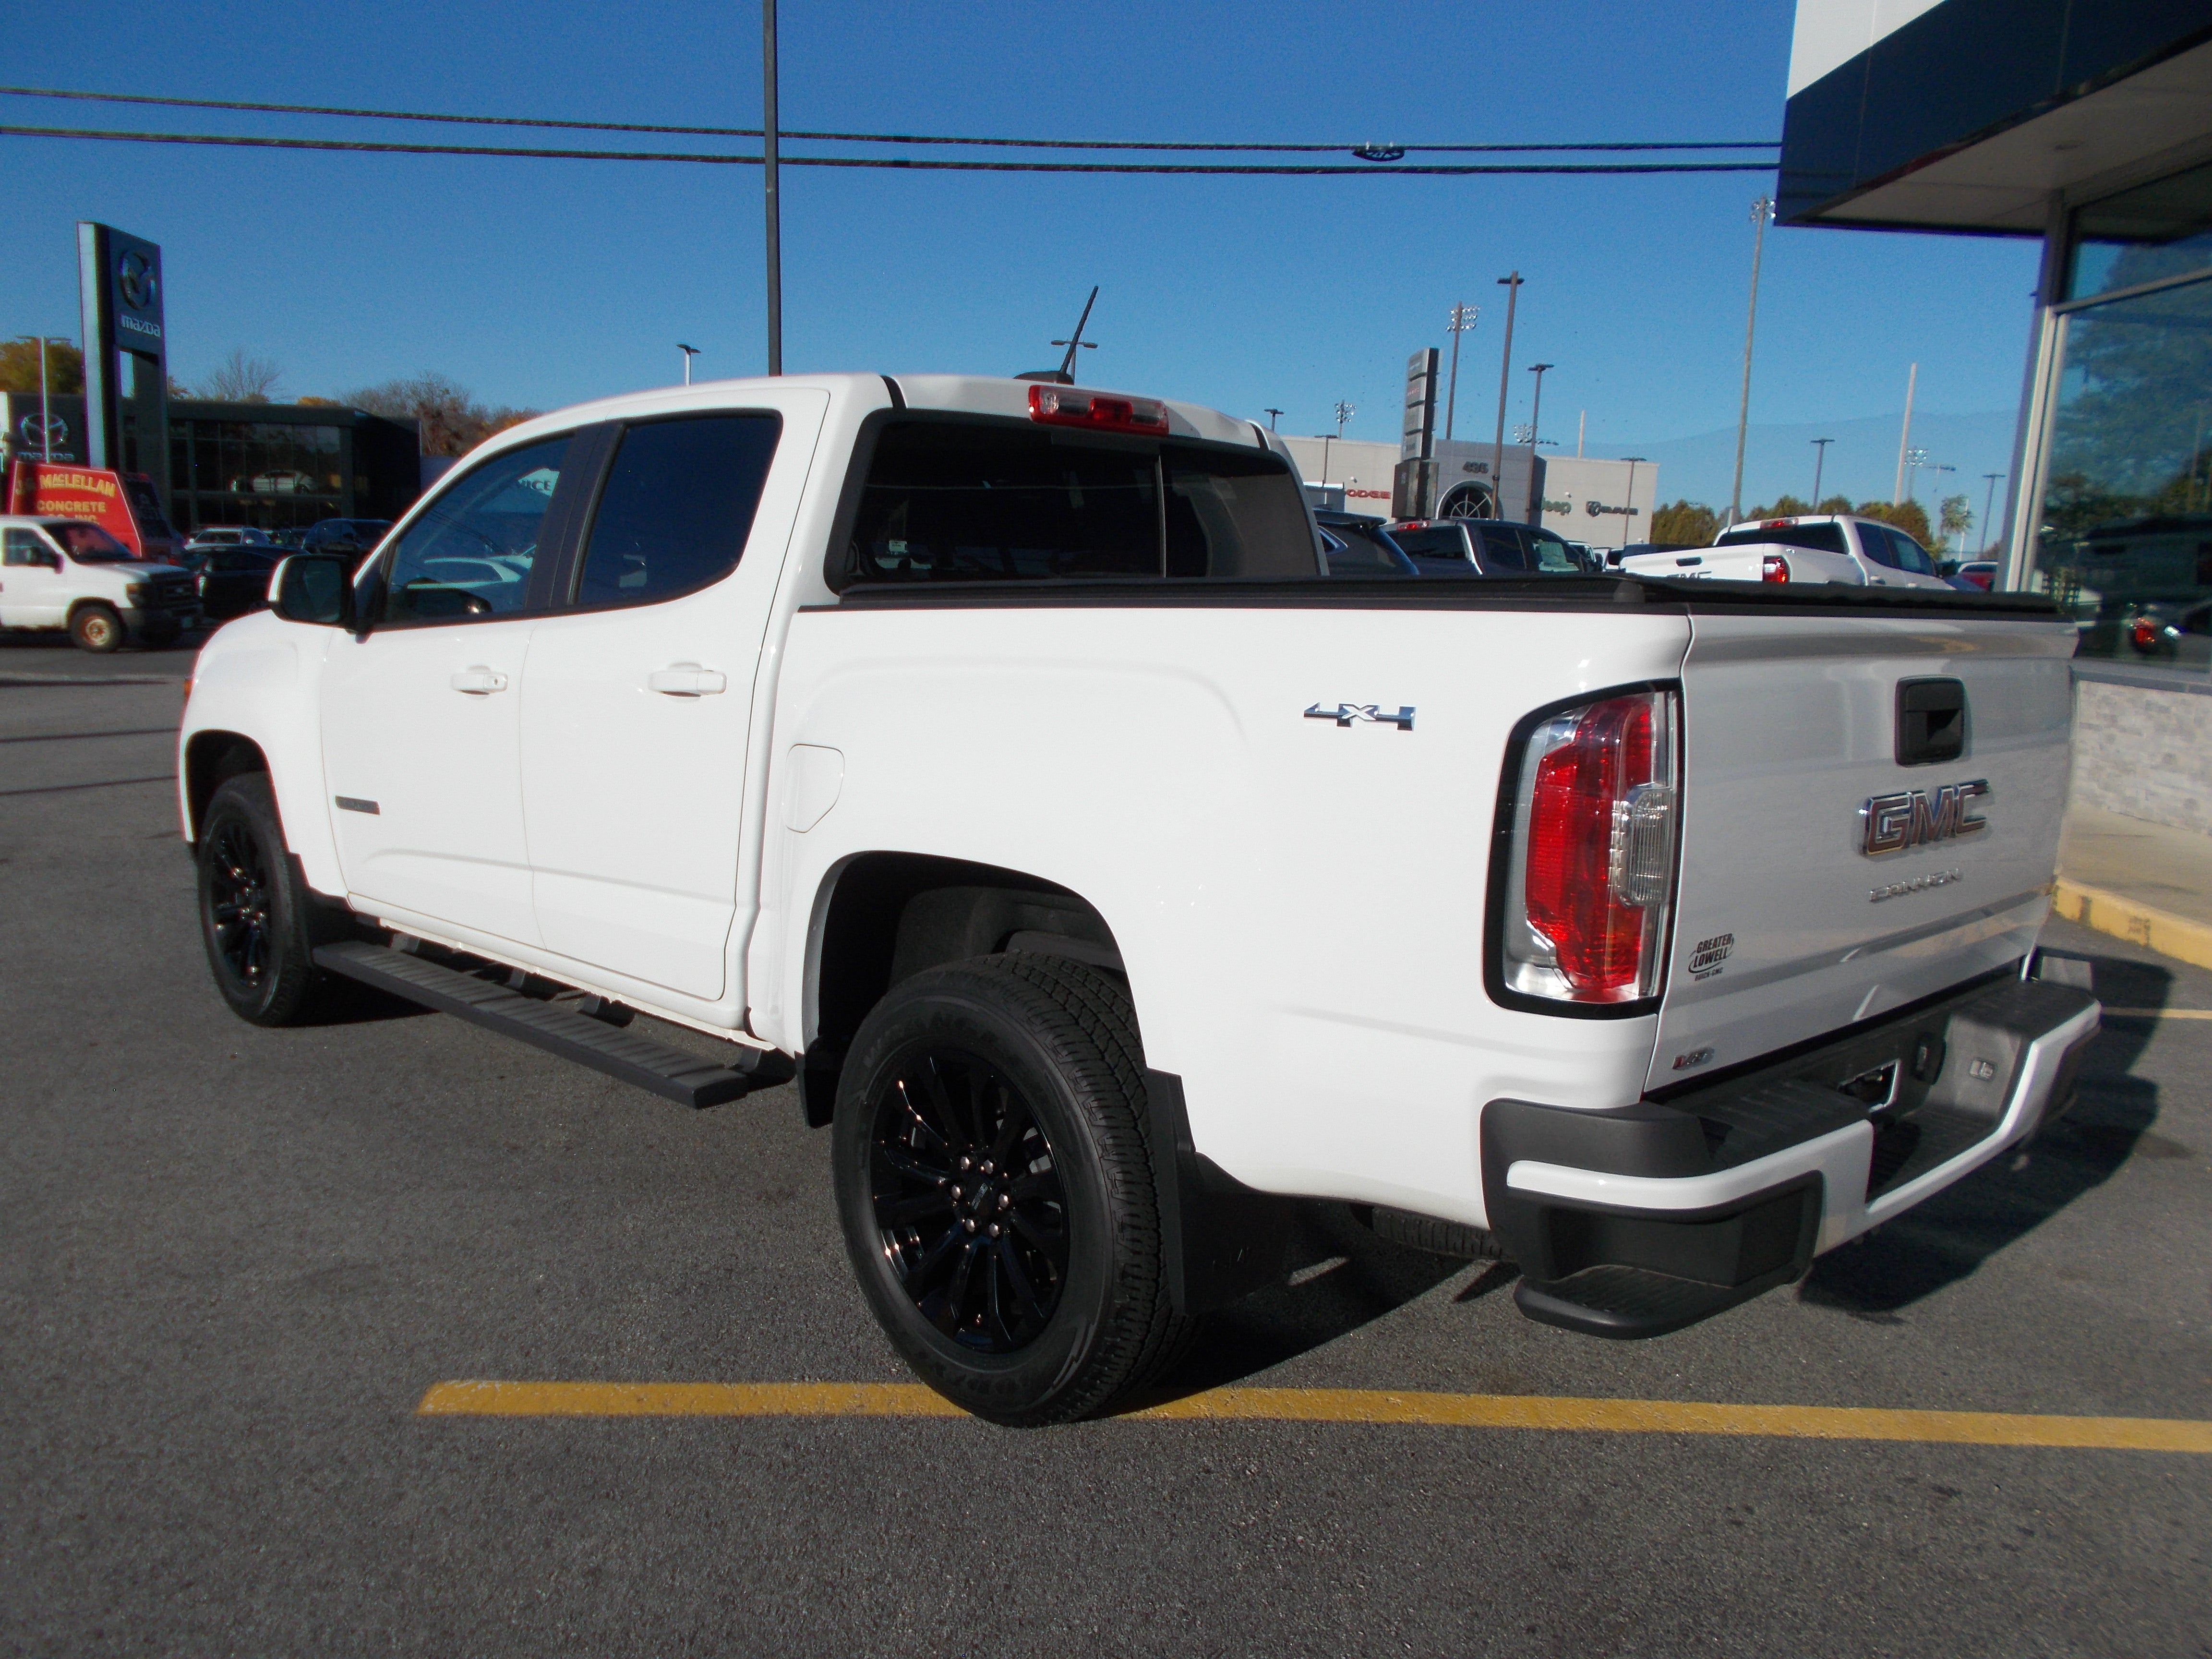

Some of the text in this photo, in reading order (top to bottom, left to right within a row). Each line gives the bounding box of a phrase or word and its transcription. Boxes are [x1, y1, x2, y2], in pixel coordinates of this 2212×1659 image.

[120, 314, 161, 337] mazda
[1345, 489, 1391, 499] ODGE
[37, 500, 107, 513] CONCRETE
[1863, 778, 1990, 855] GMC
[1696, 933, 1732, 953] GREATER
[1693, 947, 1728, 968] LOWELL
